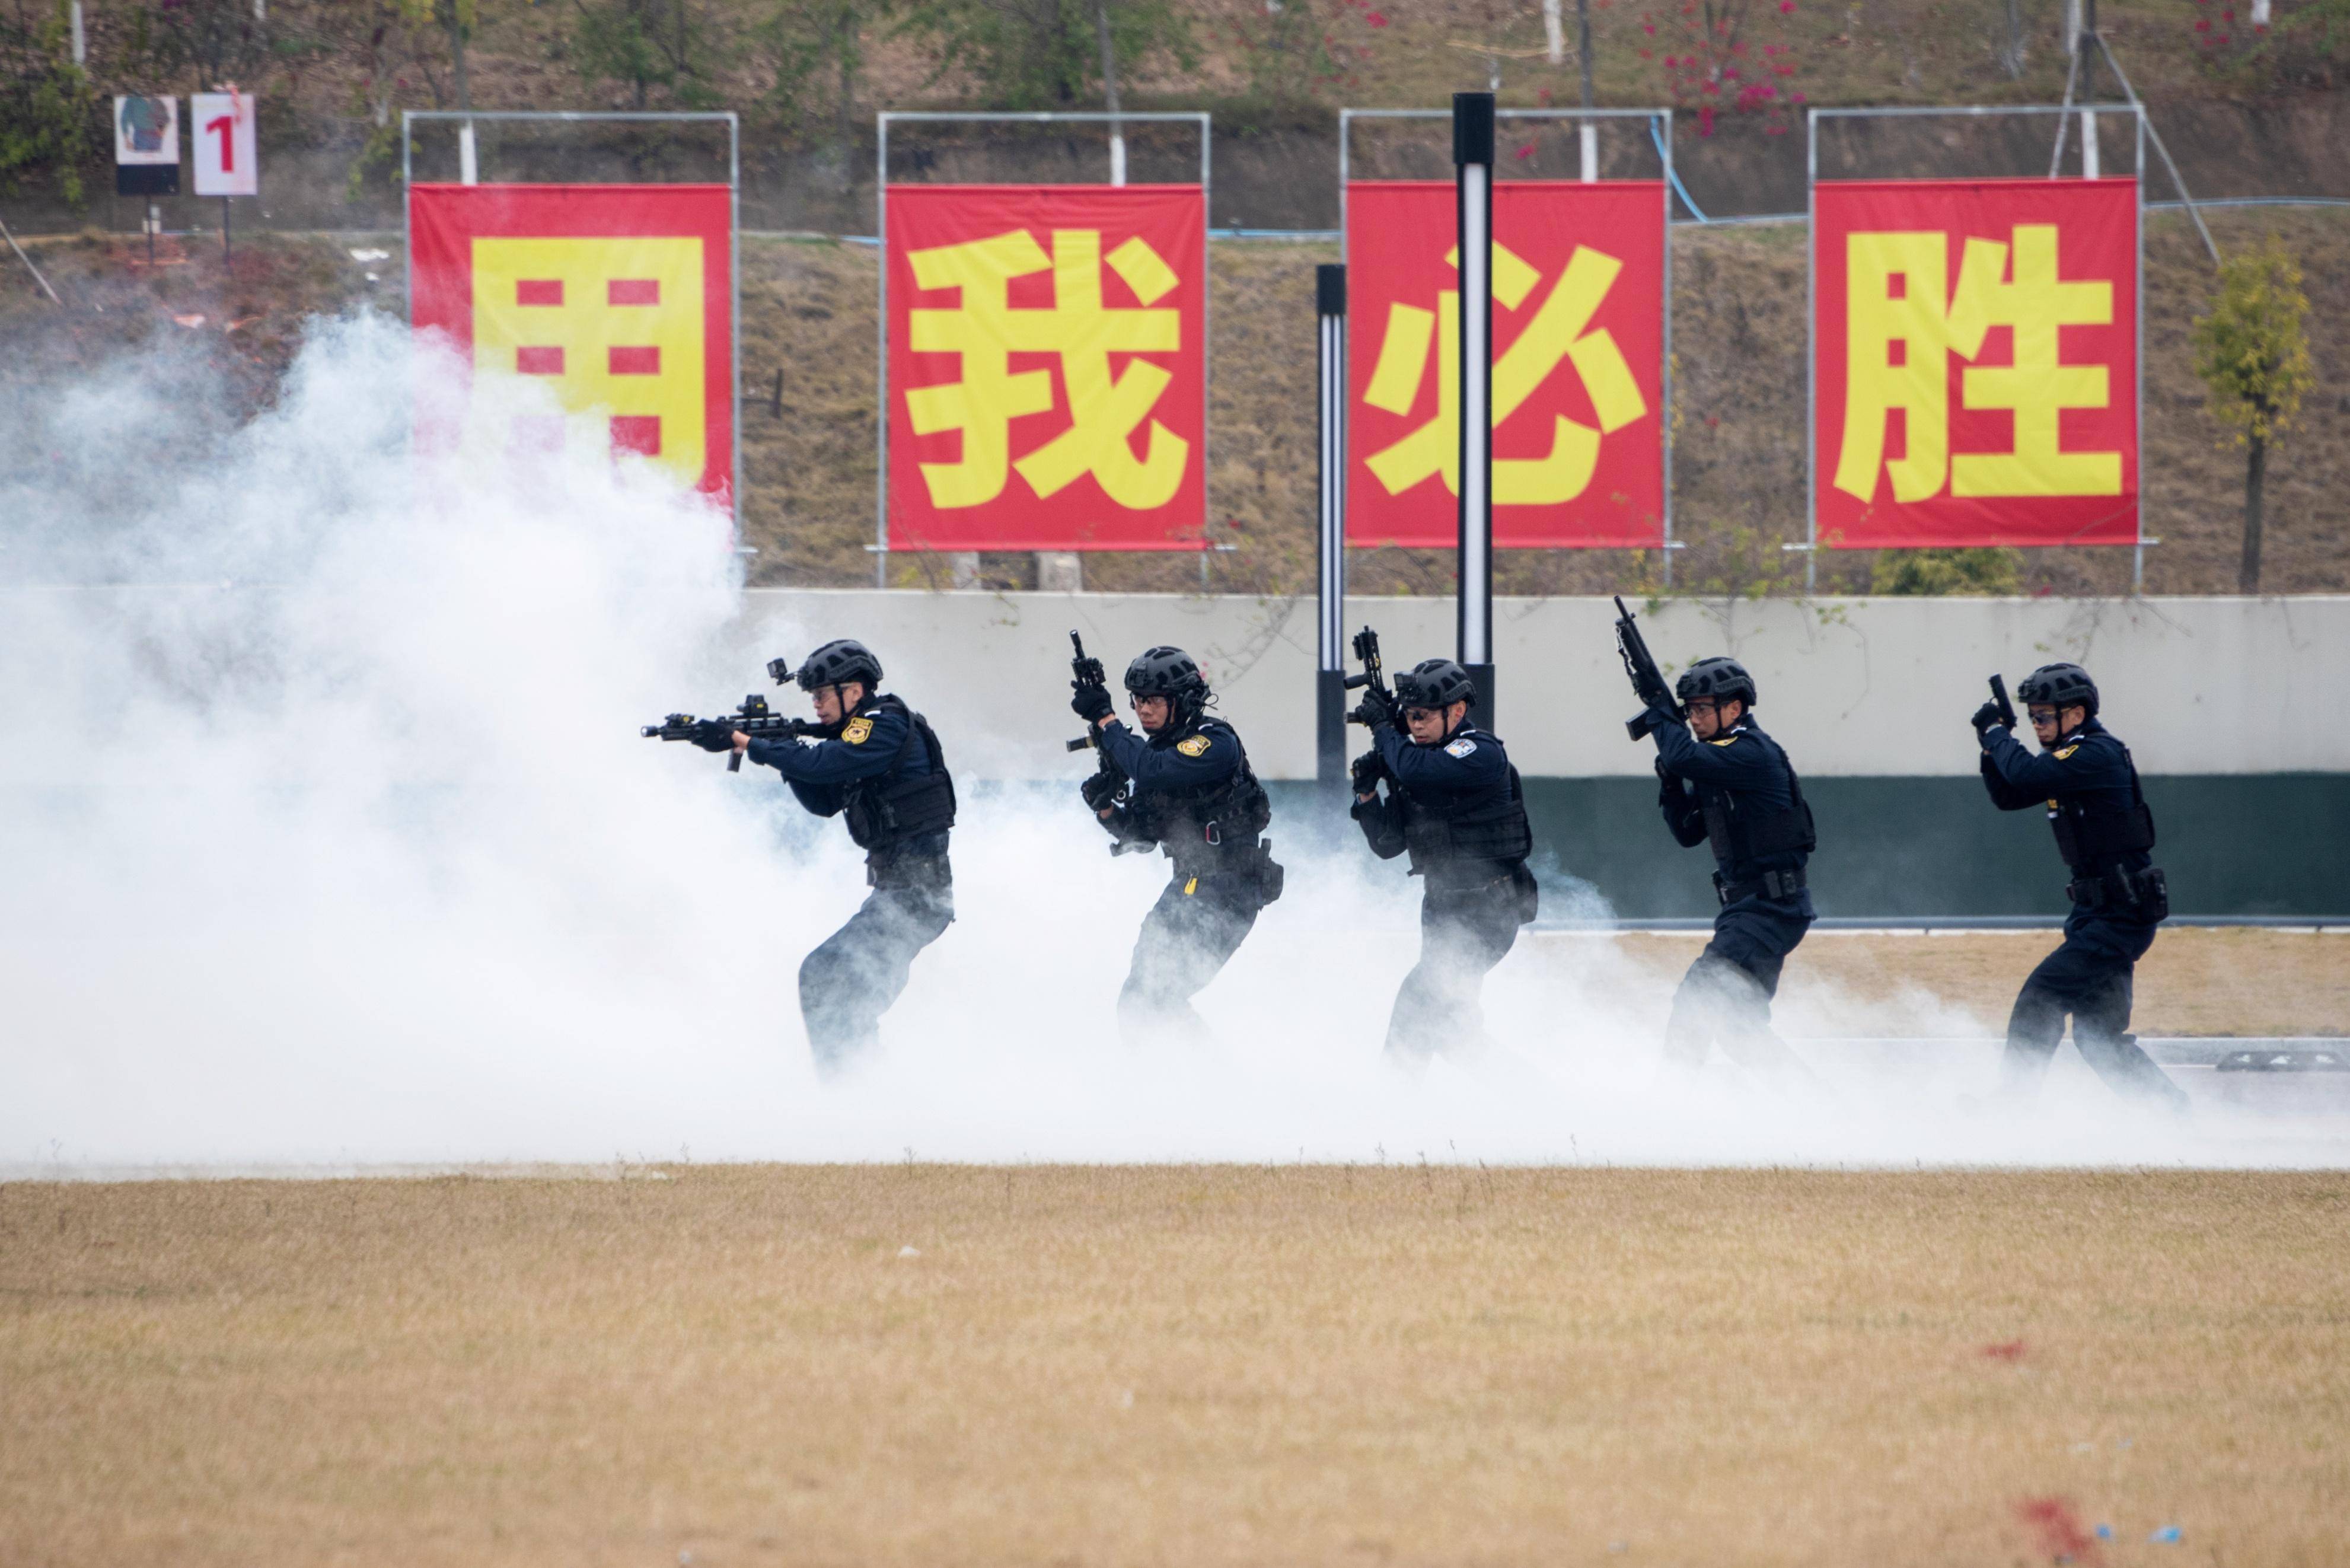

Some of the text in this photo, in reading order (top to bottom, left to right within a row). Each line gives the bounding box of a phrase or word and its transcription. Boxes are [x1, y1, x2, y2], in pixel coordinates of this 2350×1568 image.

[206, 116, 234, 173] 1
[463, 236, 706, 493] 用
[904, 229, 1190, 510] 我
[1363, 240, 1648, 505] 必
[1833, 224, 2123, 504] 胜
